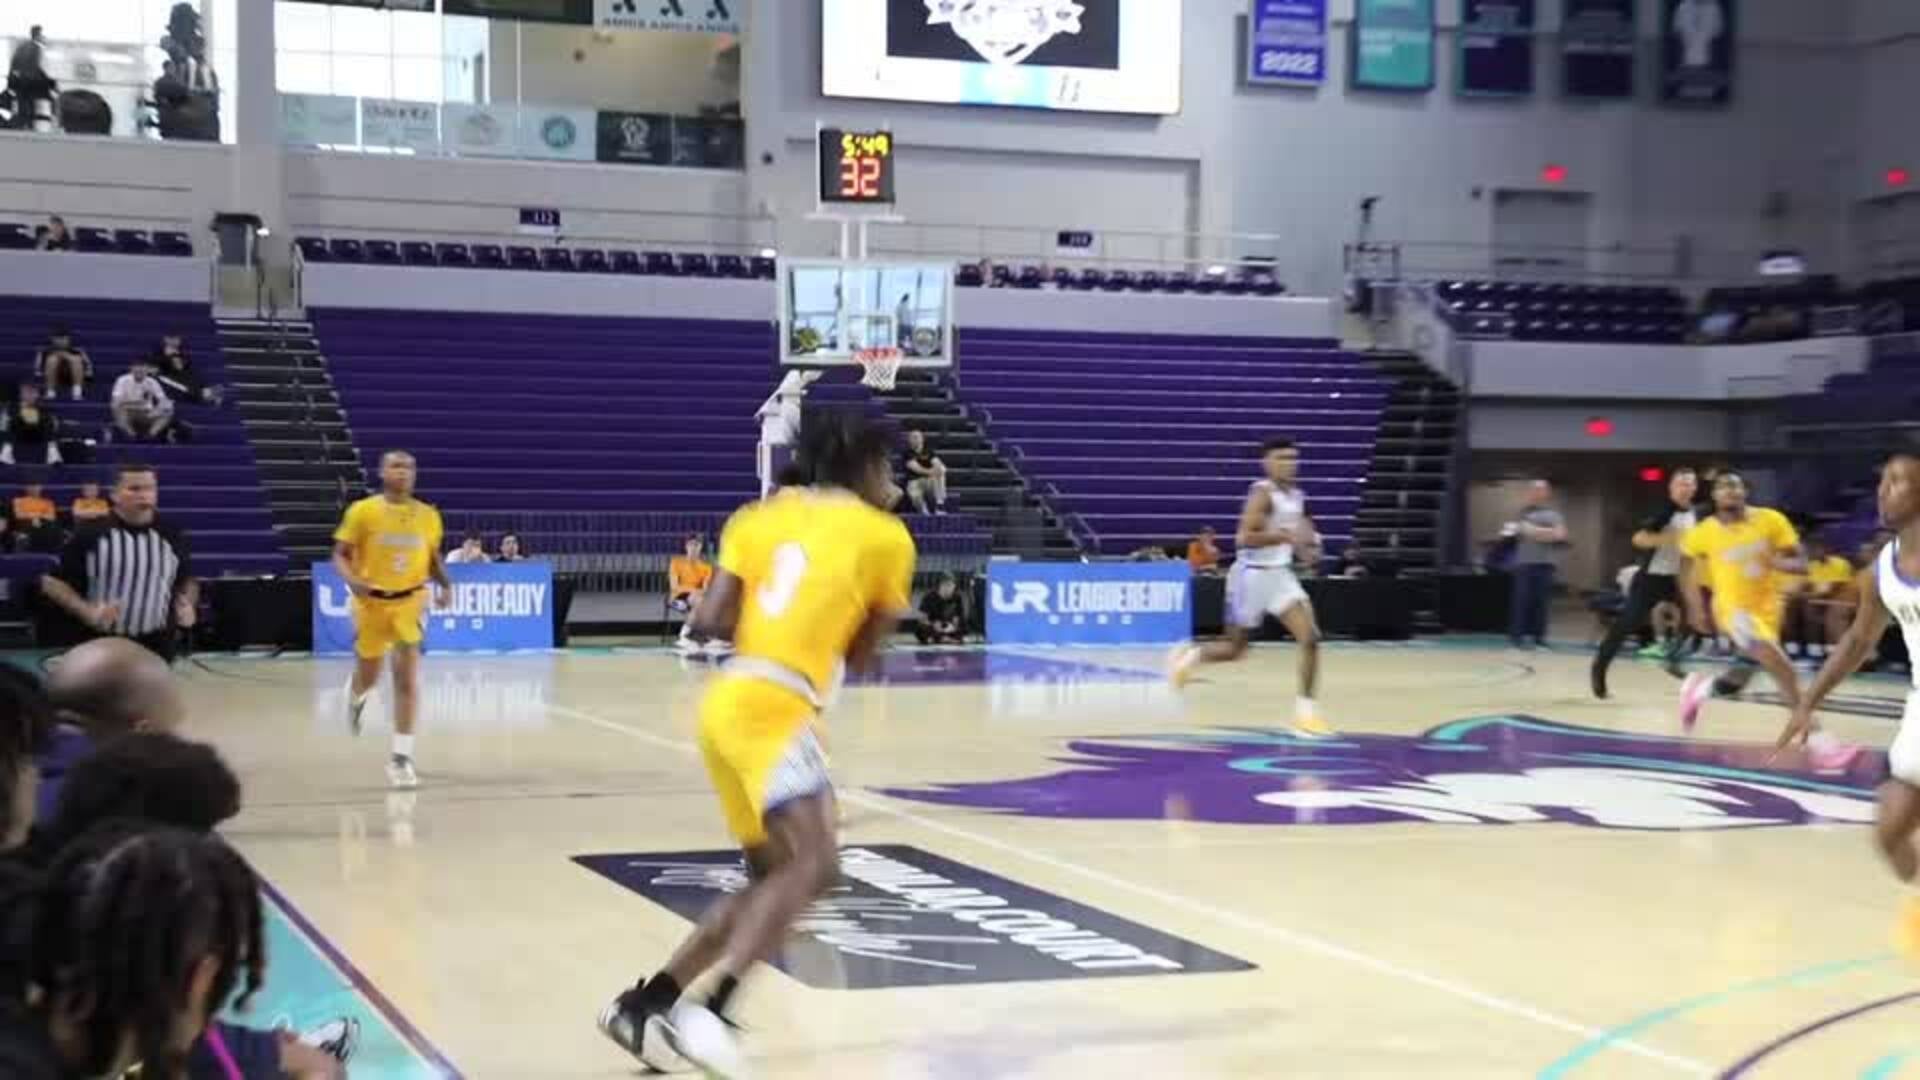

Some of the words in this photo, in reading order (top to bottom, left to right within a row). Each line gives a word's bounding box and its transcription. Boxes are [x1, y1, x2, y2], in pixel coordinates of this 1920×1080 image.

[1260, 51, 1318, 74] 2022
[841, 133, 889, 157] 5:49
[841, 158, 880, 196] 32
[952, 908, 1185, 969] COURT
